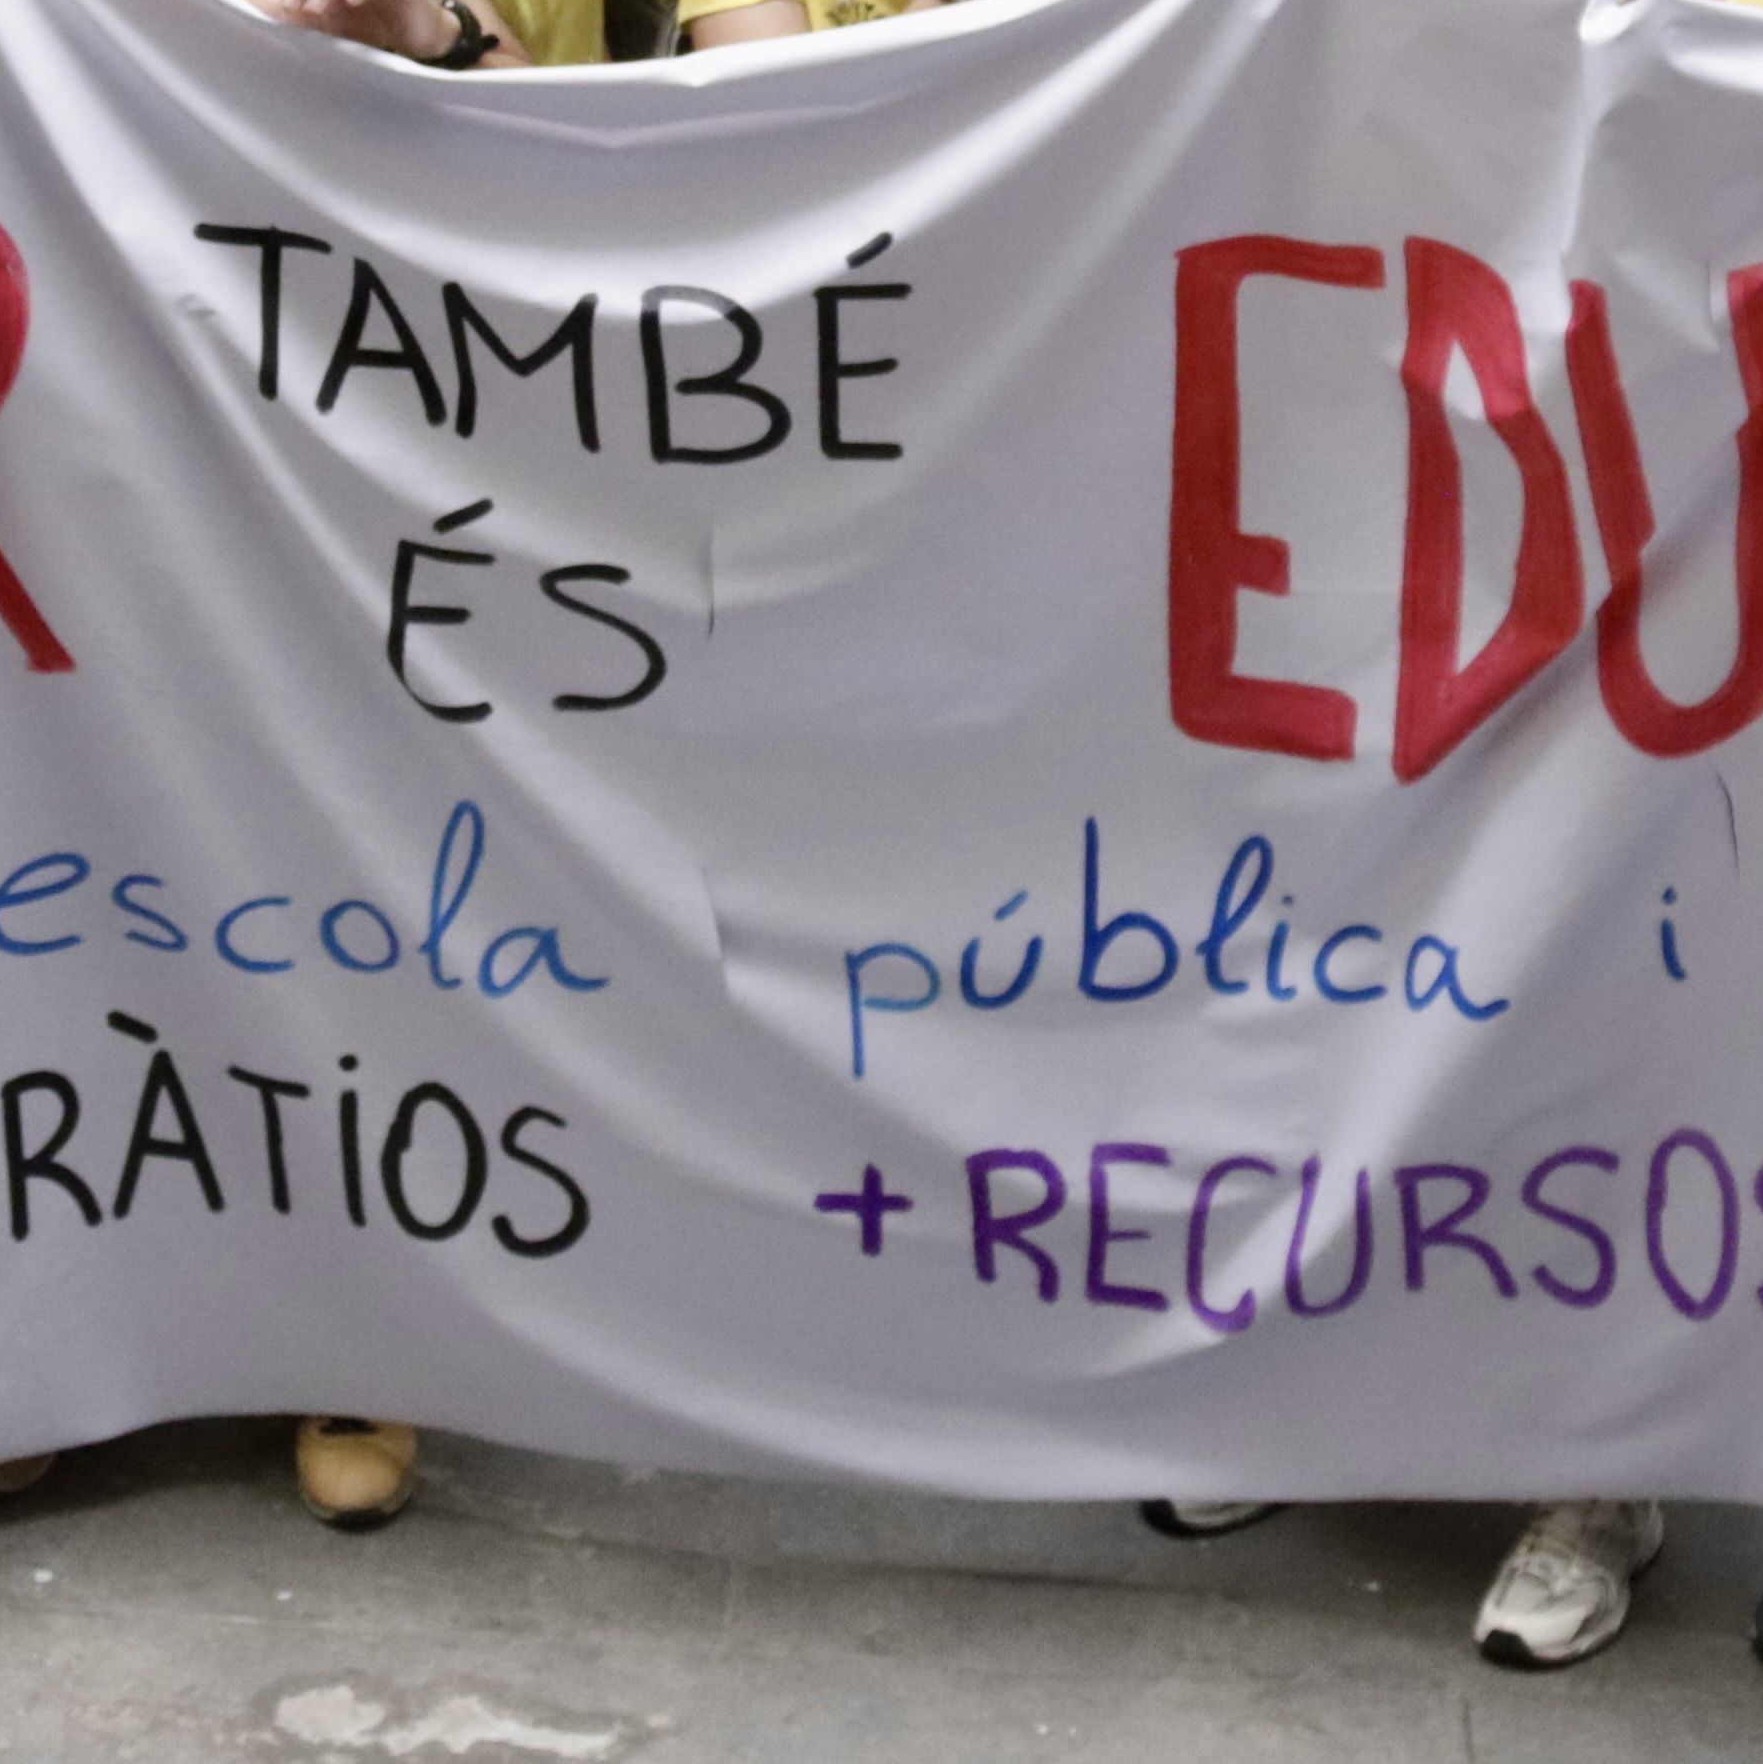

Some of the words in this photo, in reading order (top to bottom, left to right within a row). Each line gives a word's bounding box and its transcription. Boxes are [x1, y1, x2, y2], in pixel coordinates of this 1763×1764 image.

[193, 231, 913, 465] TAMBÉ
[386, 498, 668, 723] ÉS
[842, 816, 1509, 1079] pública
[1656, 887, 1688, 982] i
